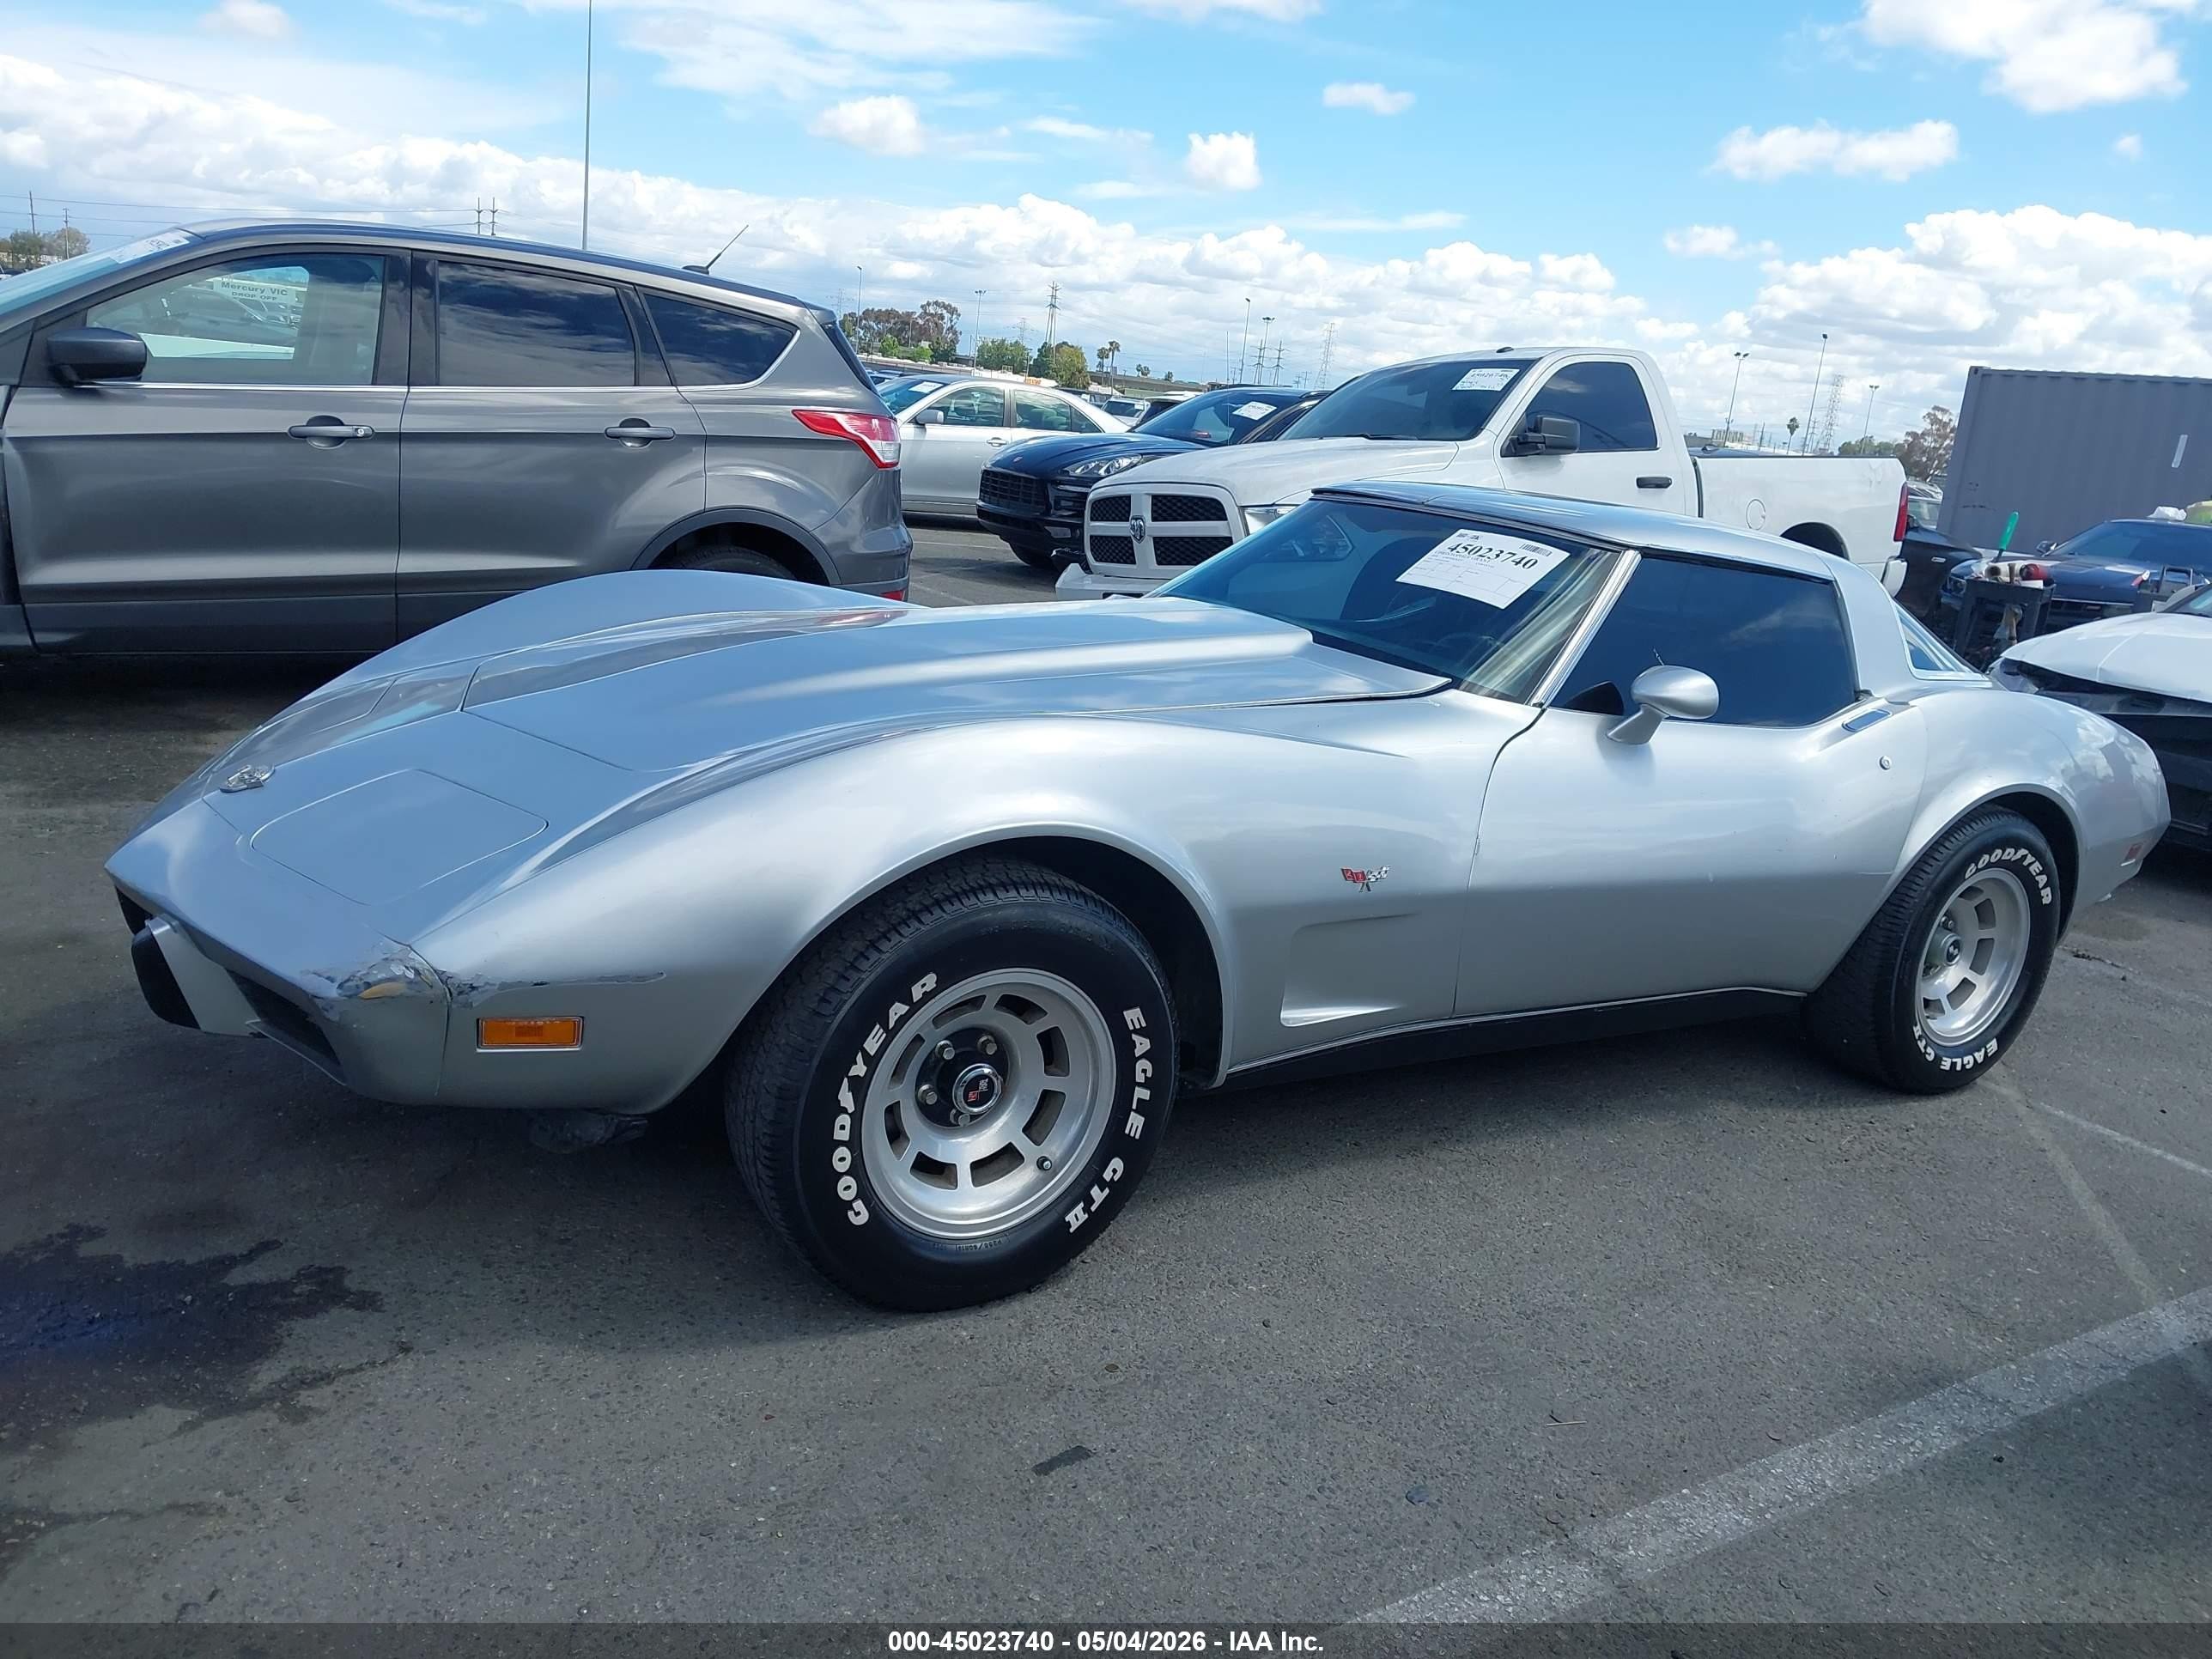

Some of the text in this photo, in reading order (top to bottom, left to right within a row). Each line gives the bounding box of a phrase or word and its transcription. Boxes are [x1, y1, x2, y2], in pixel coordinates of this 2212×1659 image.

[221, 282, 265, 294] Mercury
[1447, 542, 1539, 570] 45023740
[1965, 848, 2052, 905] GOODYEAR
[1123, 1006, 1153, 1139] EAGLE
[1940, 1037, 1999, 1071] EAGLE
[832, 972, 938, 1225] GOODYEAR
